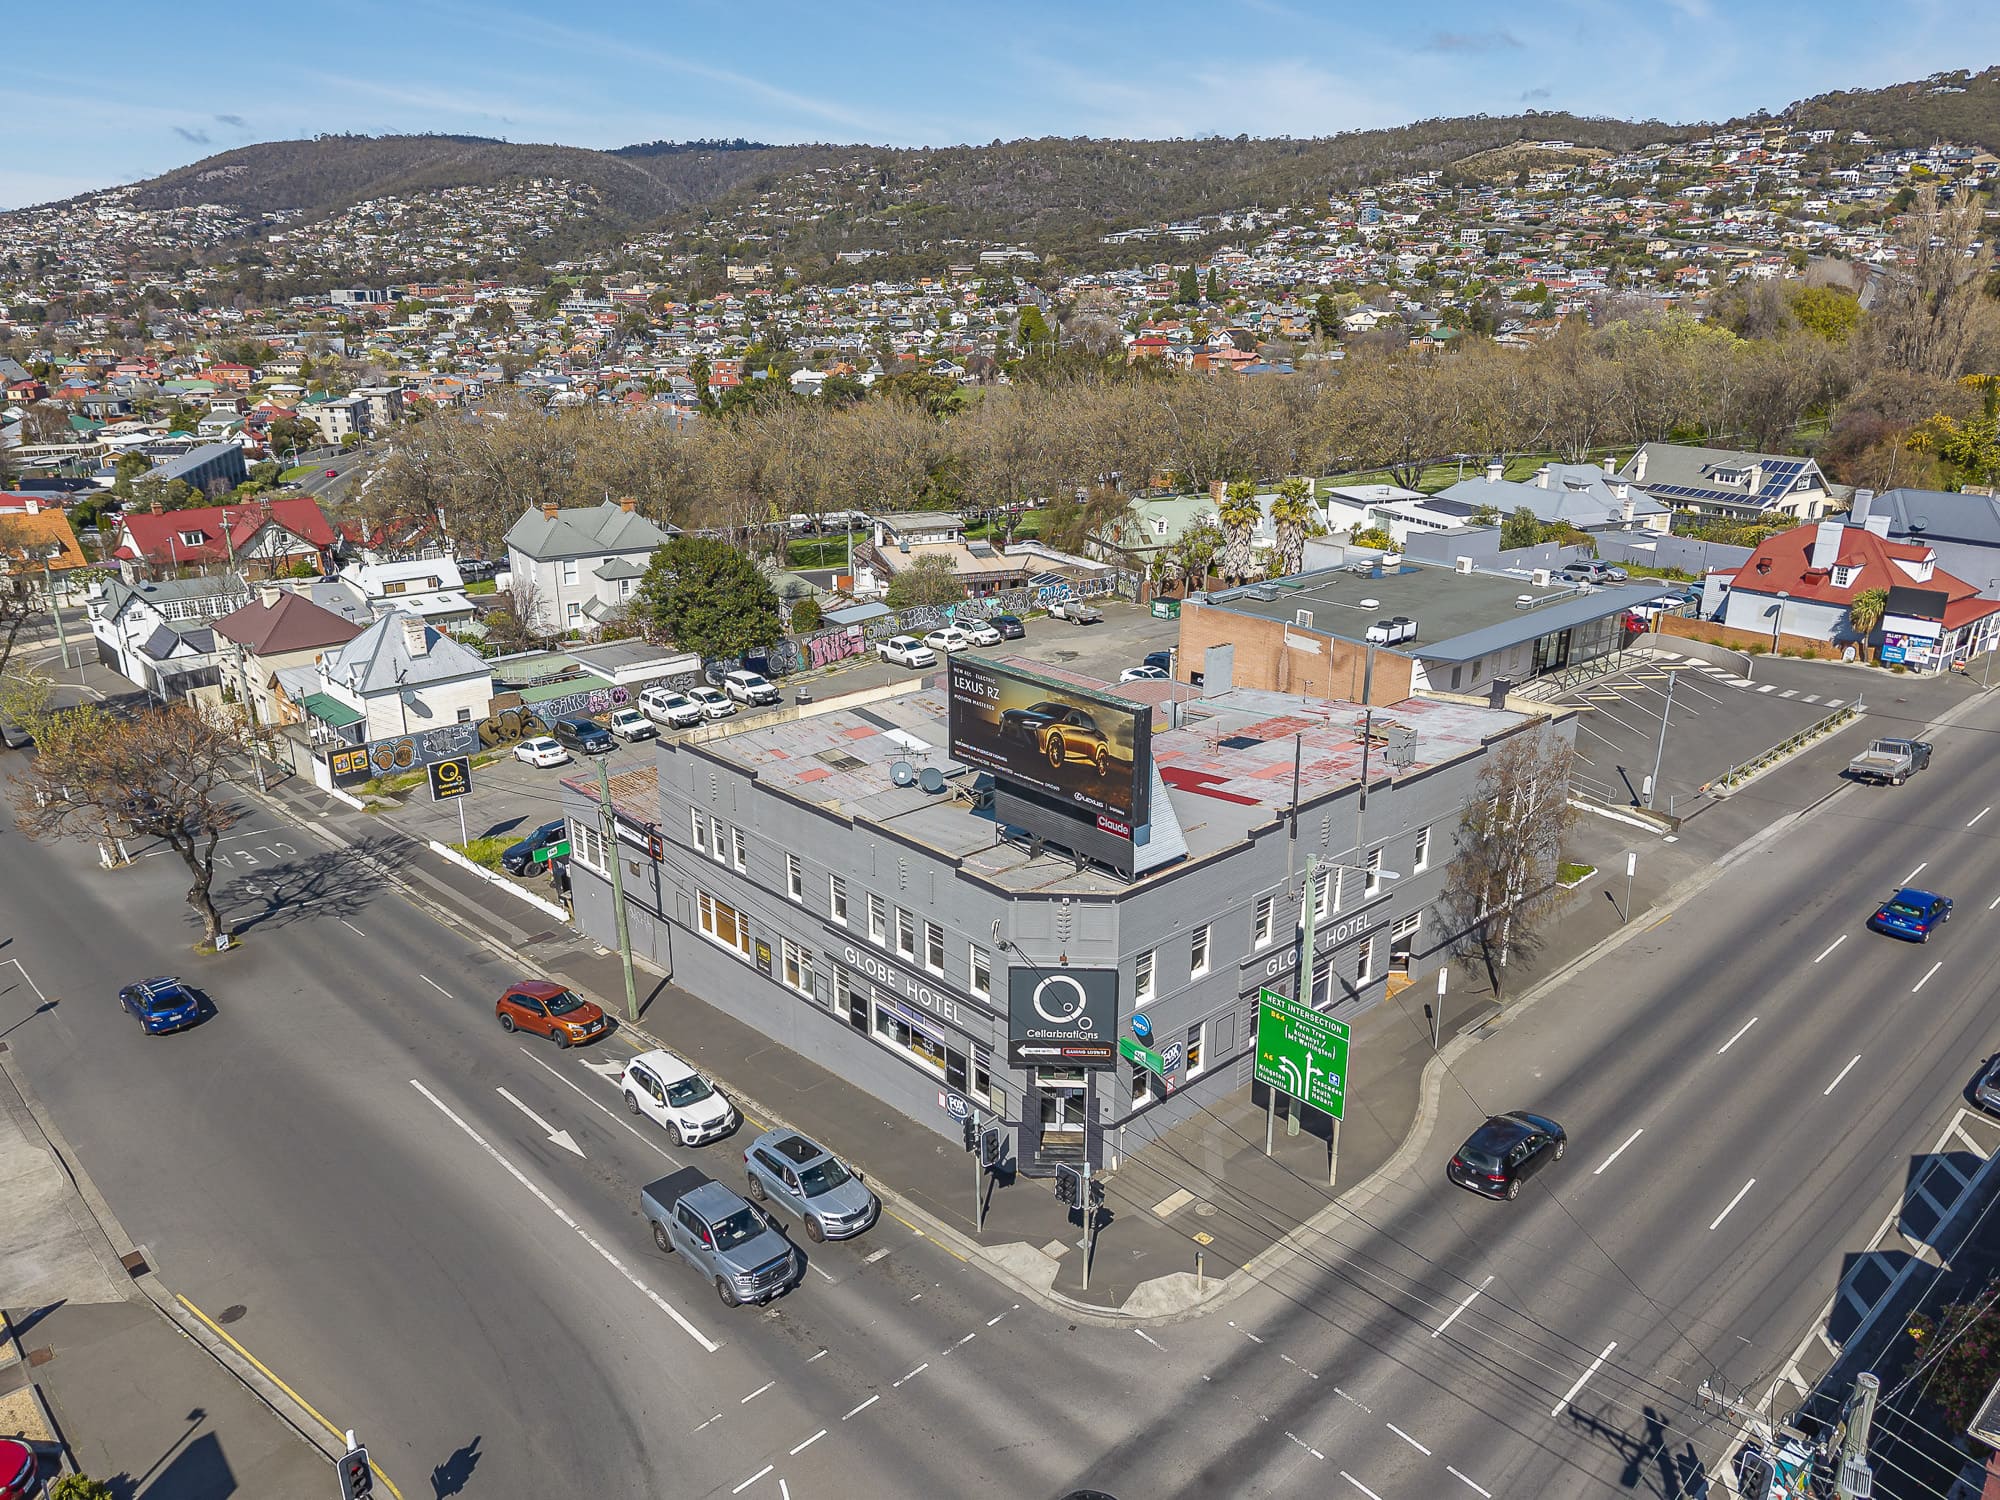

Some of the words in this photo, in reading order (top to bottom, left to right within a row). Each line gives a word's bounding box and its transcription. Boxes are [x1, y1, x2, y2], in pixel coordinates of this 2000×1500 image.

[954, 676, 984, 695] LEXUS
[987, 686, 1000, 700] RZ
[1098, 816, 1128, 835] Claude
[1326, 914, 1372, 948] HOTEL
[844, 946, 896, 988] GLOBE
[906, 979, 964, 1026] HOTEL
[1266, 994, 1286, 1009] NEXT
[1288, 1003, 1342, 1034] INTERSECTION
[1270, 1010, 1286, 1022] B64
[1026, 1029, 1099, 1040] Cellarbrations
[1295, 1021, 1310, 1033] Fern
[1311, 1029, 1326, 1040] Tree
[1163, 1044, 1180, 1065] FOX
[1263, 1052, 1274, 1061] A6
[1258, 1071, 1287, 1090] Huonville
[1259, 1064, 1286, 1081] Kingston
[1312, 1078, 1342, 1096] Cascades
[1312, 1086, 1331, 1099] South
[949, 1097, 965, 1112] FOX
[1312, 1092, 1333, 1107] Hobart
